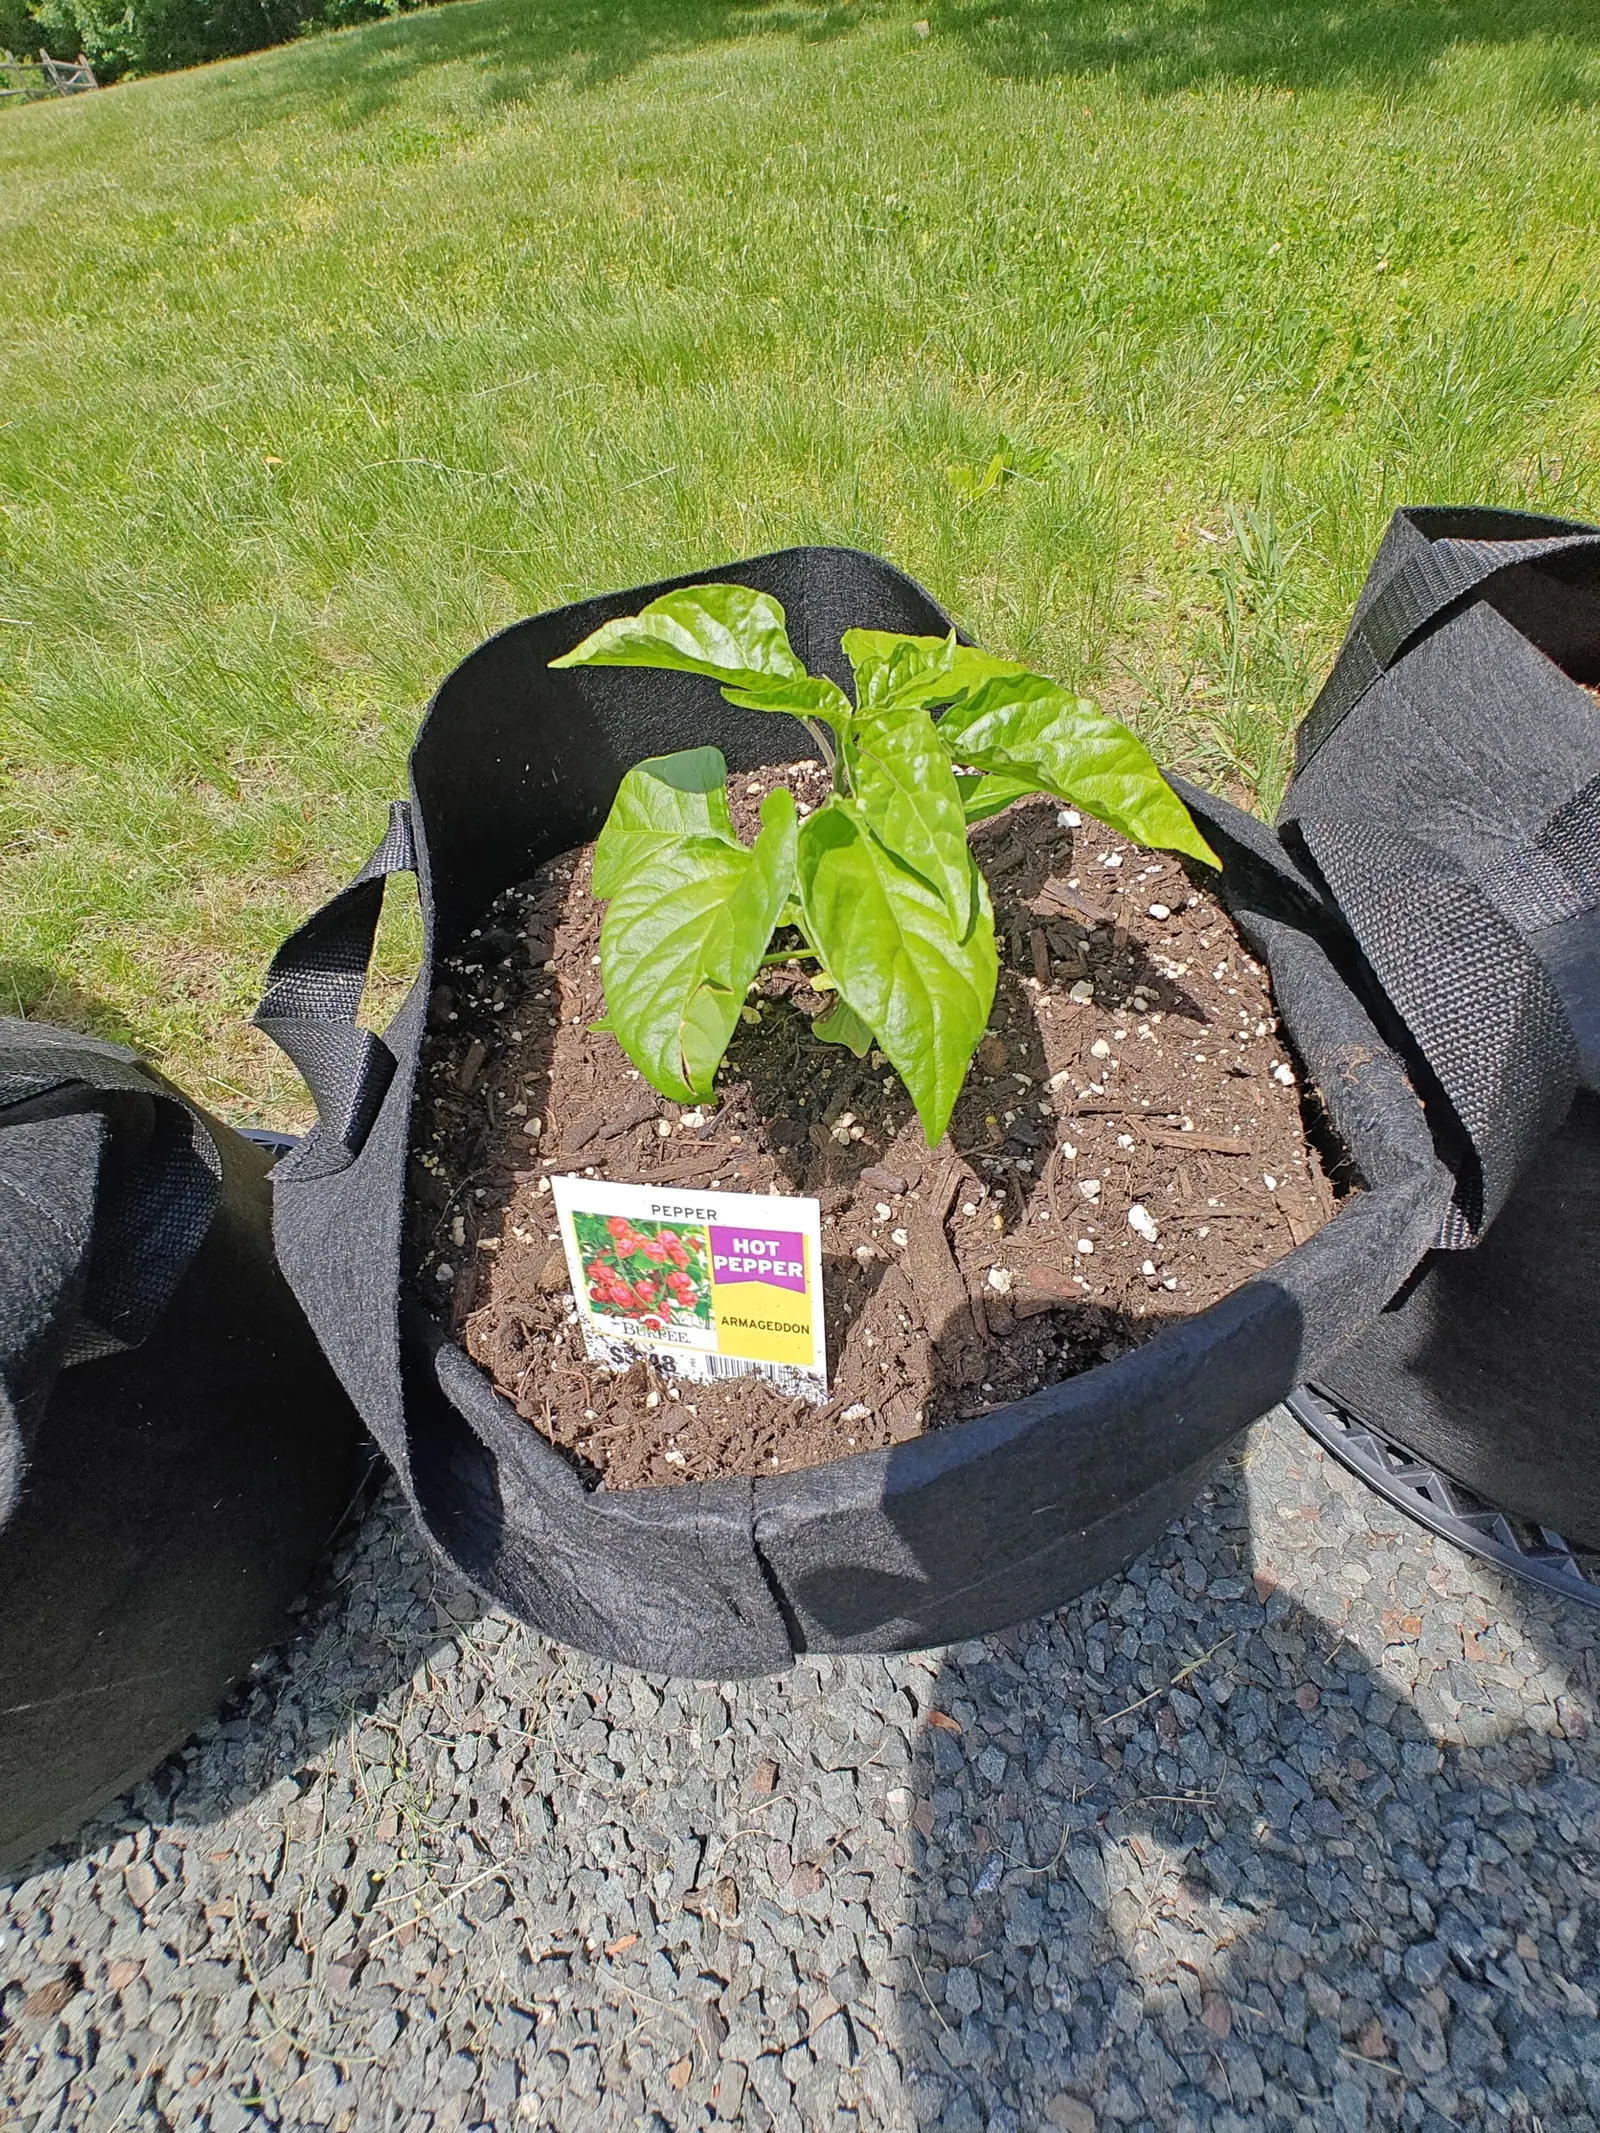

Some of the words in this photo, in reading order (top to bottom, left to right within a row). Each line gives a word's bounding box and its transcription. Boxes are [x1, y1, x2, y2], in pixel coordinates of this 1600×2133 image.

[651, 1204, 717, 1221] PEPPER
[733, 1237, 780, 1256] HOT
[713, 1255, 803, 1277] PEPPER
[621, 1321, 688, 1344] BURPEE
[721, 1316, 810, 1334] ARMAGEDDON
